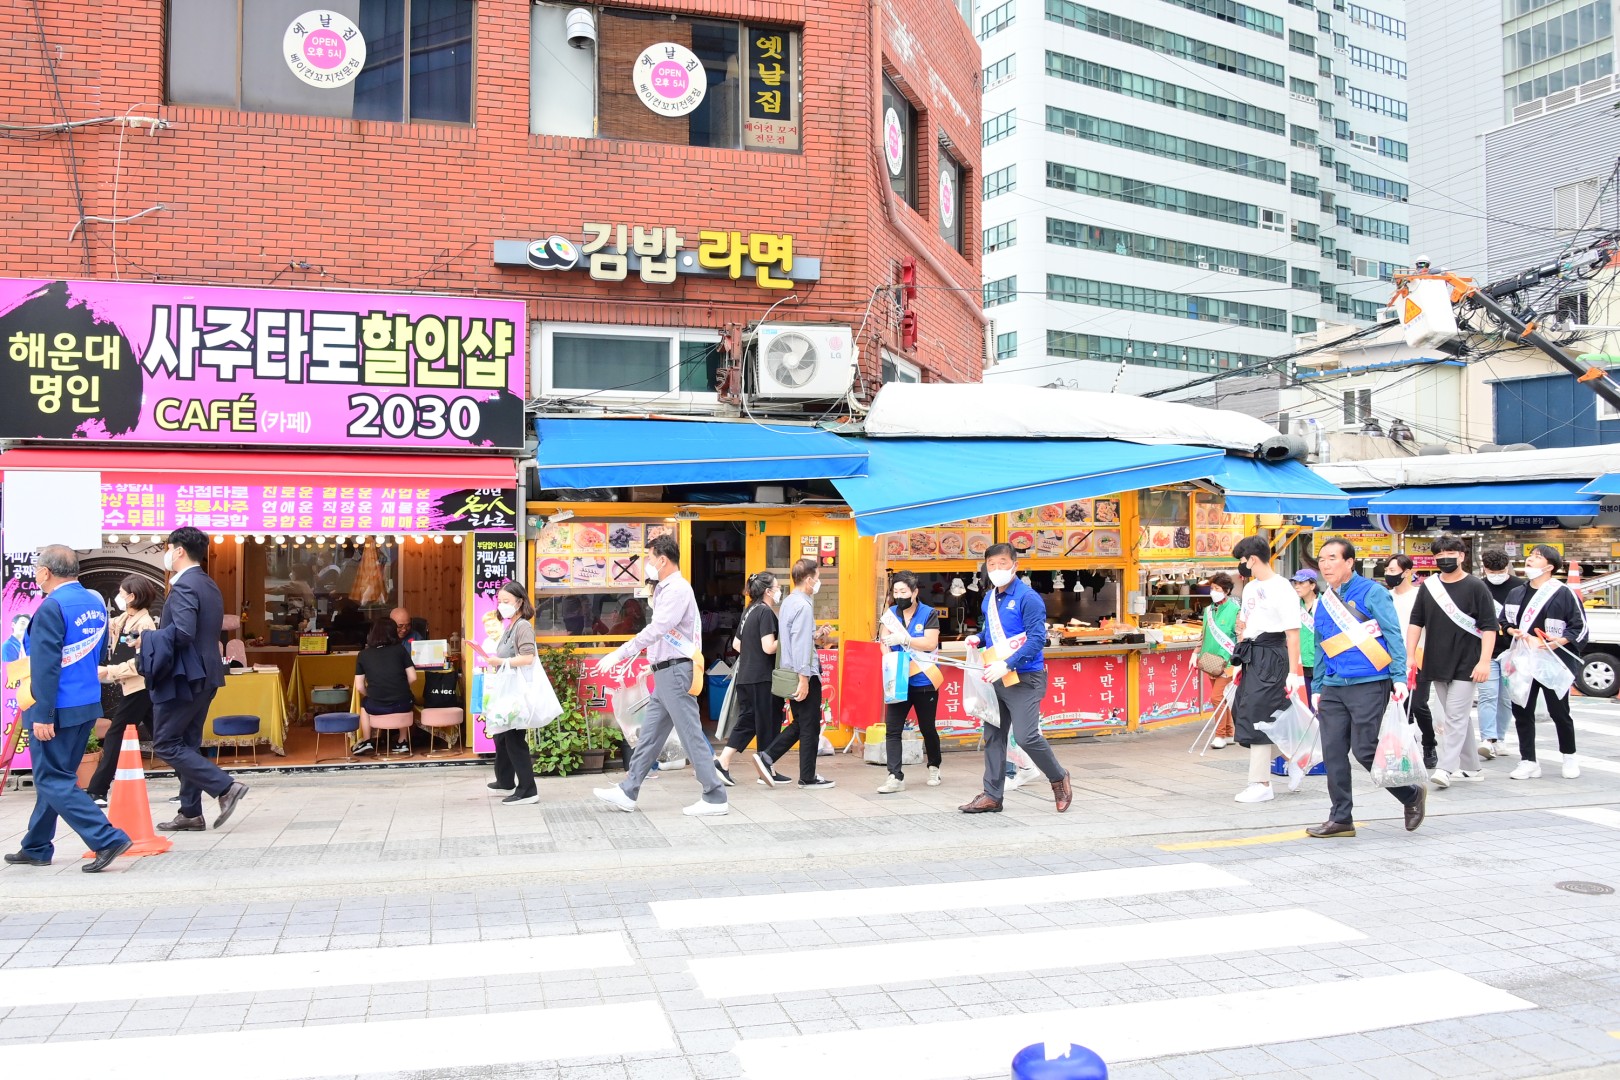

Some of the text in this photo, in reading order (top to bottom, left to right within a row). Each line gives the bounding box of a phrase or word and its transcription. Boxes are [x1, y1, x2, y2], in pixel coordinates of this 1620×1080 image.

[311, 36, 338, 46] OPEN
[307, 47, 342, 59] 오후 5시
[658, 67, 682, 78] OPEN
[755, 35, 785, 114] 옛날집
[654, 78, 686, 89] 오후 5시
[744, 123, 773, 134] 베이컨
[755, 134, 786, 145] 전문점
[8, 330, 120, 371] 해운대
[142, 303, 515, 389] 사주타로할인샵
[29, 375, 100, 414] 명인
[154, 393, 312, 434] CAFÉ (카페)
[347, 393, 481, 439] 2030
[176, 486, 249, 499] 신점타로
[262, 486, 313, 499] 진로운
[126, 493, 165, 508] 무료!!
[175, 499, 249, 513] 정통사주
[262, 501, 313, 513] 연애운
[322, 501, 372, 513] 직장운
[127, 509, 165, 527] 무료!!
[175, 514, 249, 528] 커플궁합
[262, 516, 313, 528] 궁합운
[322, 516, 372, 528] 진급운
[381, 516, 430, 529] 매매운
[476, 551, 516, 565] 커피/음료
[484, 564, 508, 579] 공짜!!
[944, 680, 961, 696] 산
[1052, 674, 1114, 690] 묵 만
[944, 698, 961, 713] 급
[1053, 690, 1114, 707] 니 다
